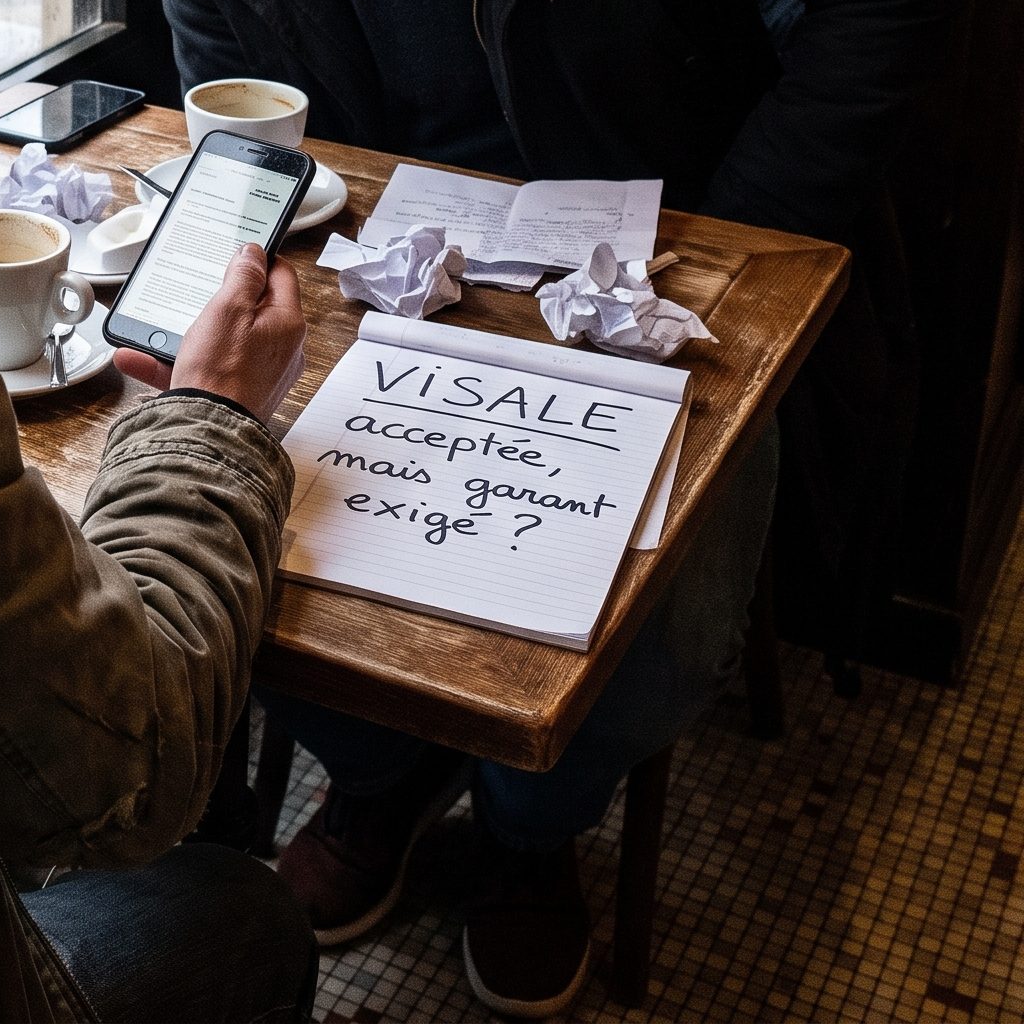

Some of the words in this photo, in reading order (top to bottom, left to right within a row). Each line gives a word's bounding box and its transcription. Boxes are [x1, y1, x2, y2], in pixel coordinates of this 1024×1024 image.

[344, 414, 562, 478] acceptée,
[317, 449, 432, 484] mais
[464, 478, 617, 519] garant
[343, 493, 493, 546] exigé
[510, 513, 543, 551] ?
